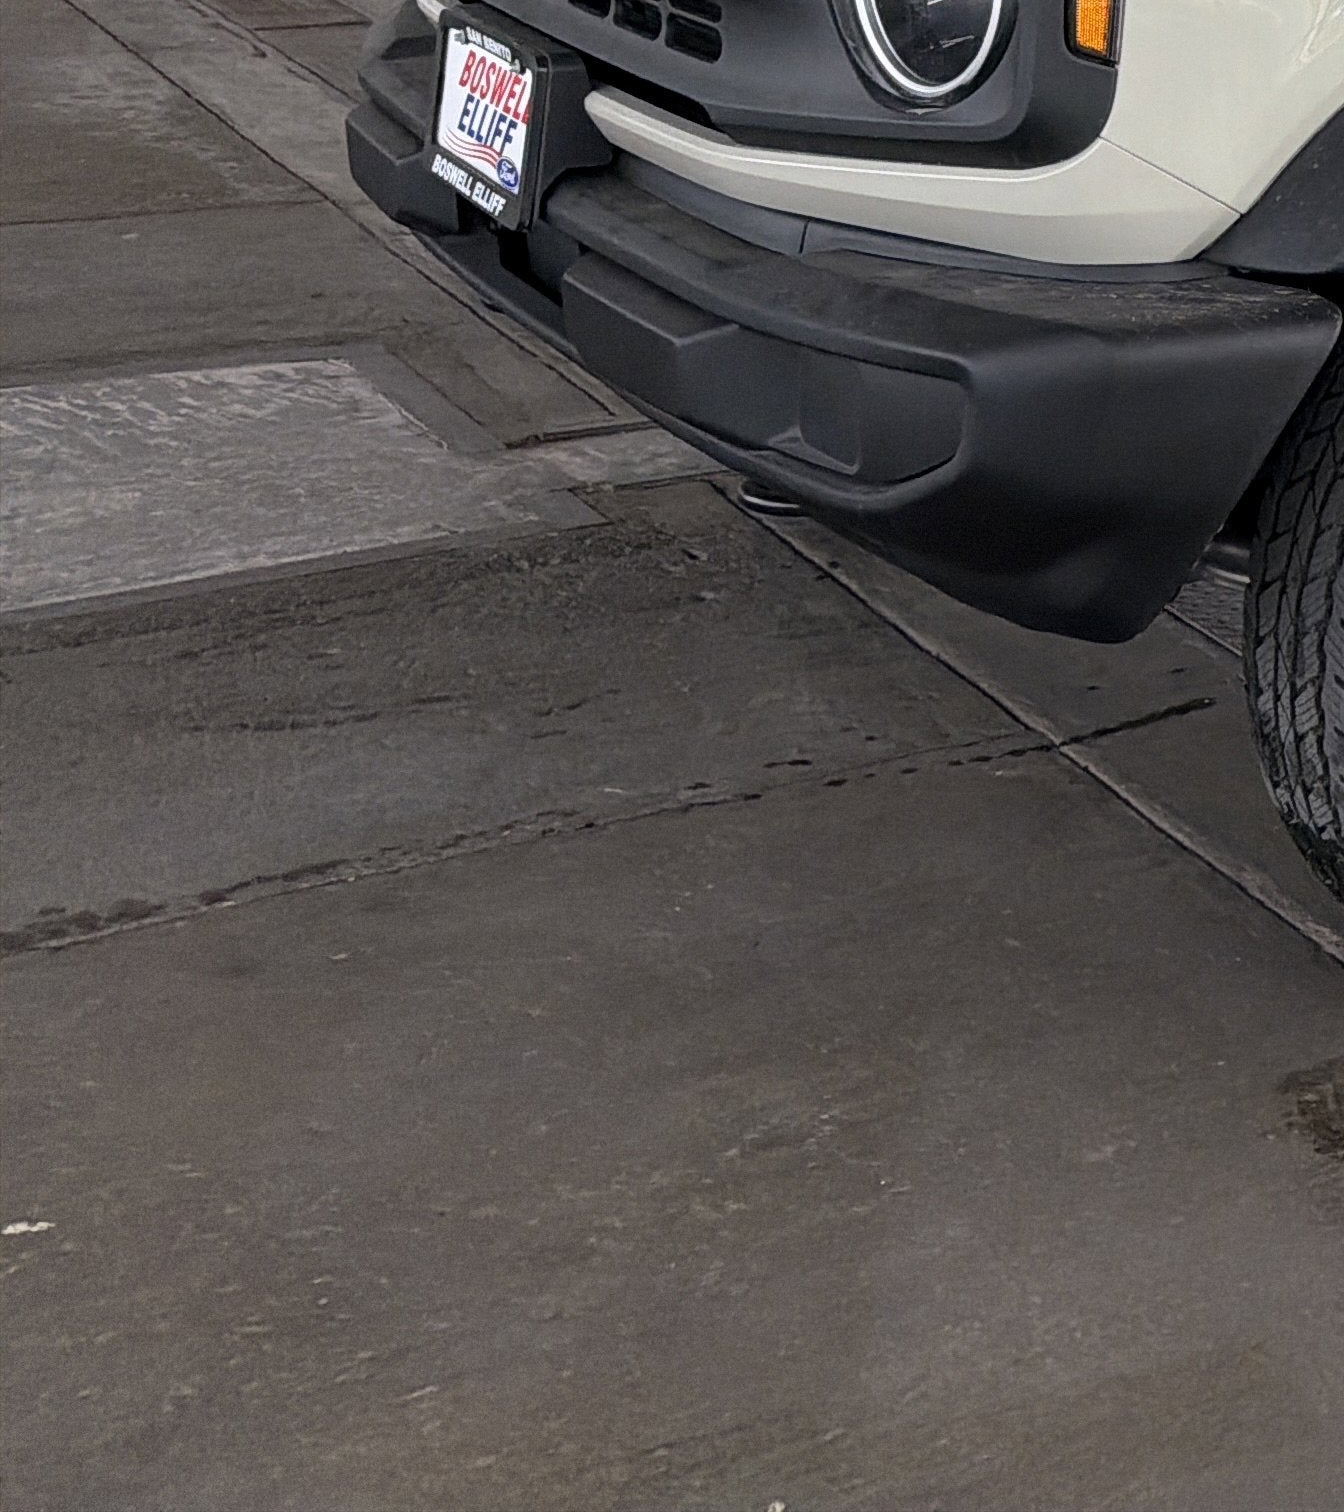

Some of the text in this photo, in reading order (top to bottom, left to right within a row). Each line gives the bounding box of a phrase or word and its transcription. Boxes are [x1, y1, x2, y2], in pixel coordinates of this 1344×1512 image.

[457, 92, 519, 158] ELLIFF
[431, 153, 507, 217] BOSWELL ELLIFF
